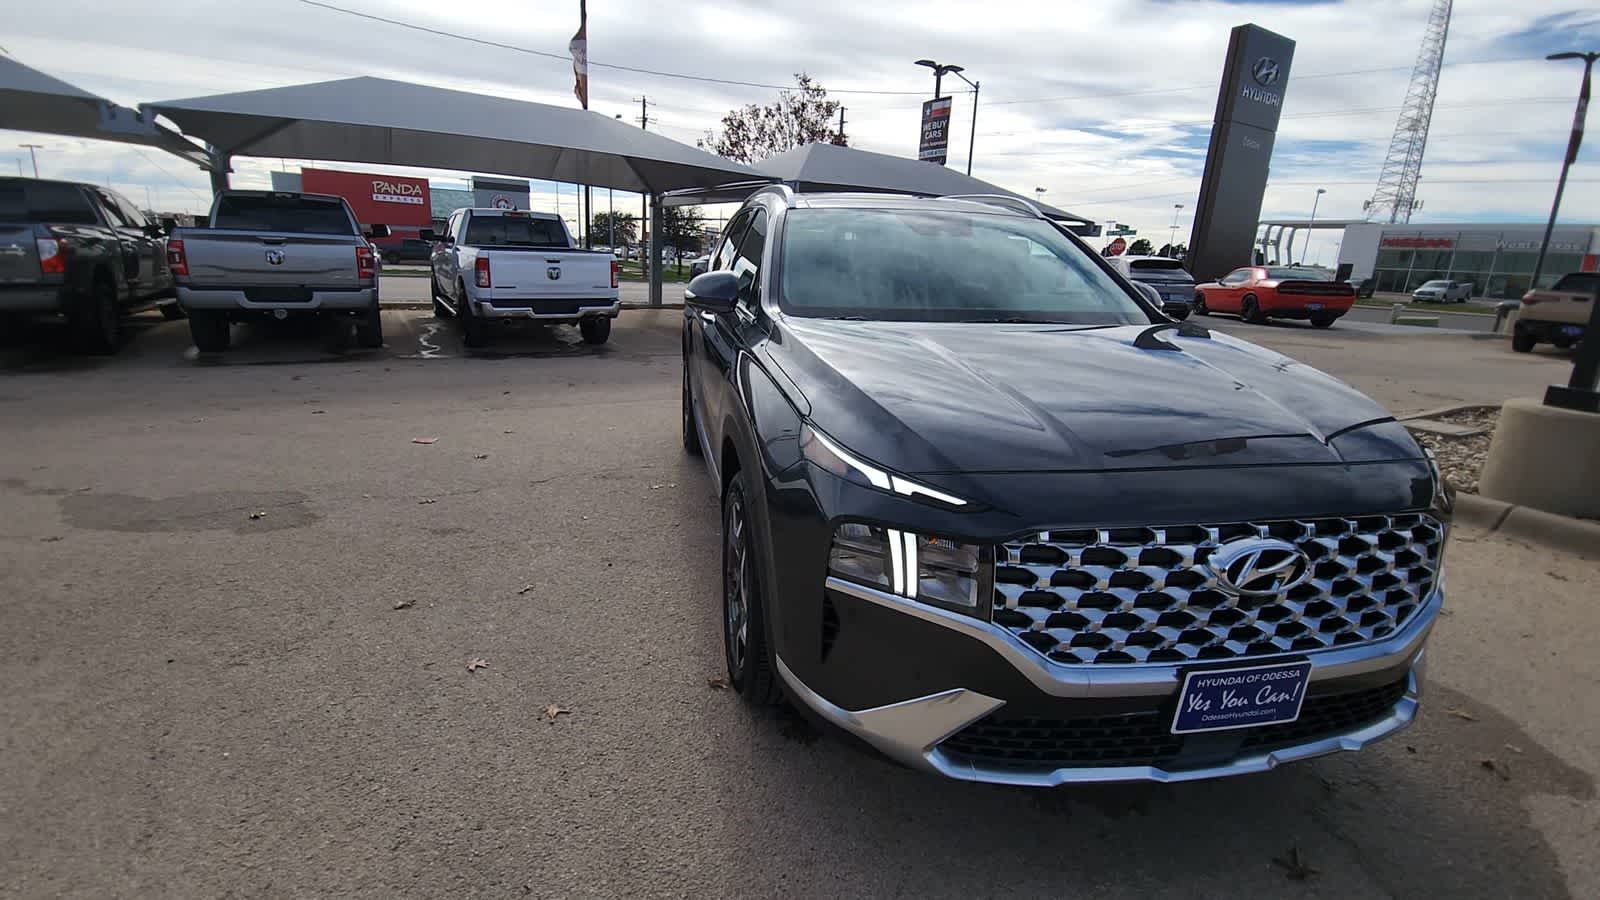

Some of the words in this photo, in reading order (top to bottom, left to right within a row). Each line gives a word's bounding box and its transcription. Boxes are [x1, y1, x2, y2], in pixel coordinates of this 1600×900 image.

[1242, 86, 1280, 107] HYUNDAI
[932, 119, 947, 129] BUY
[925, 130, 942, 140] CARS
[372, 181, 422, 196] PANDA
[1197, 676, 1245, 688] HYUNDAI
[1246, 675, 1261, 683] OF
[1261, 670, 1300, 681] ODESSA
[1187, 692, 1212, 713] Yes
[1220, 689, 1248, 710] You
[1255, 681, 1301, 705] Can!
[1201, 708, 1277, 722] OdessaHyundai.com
